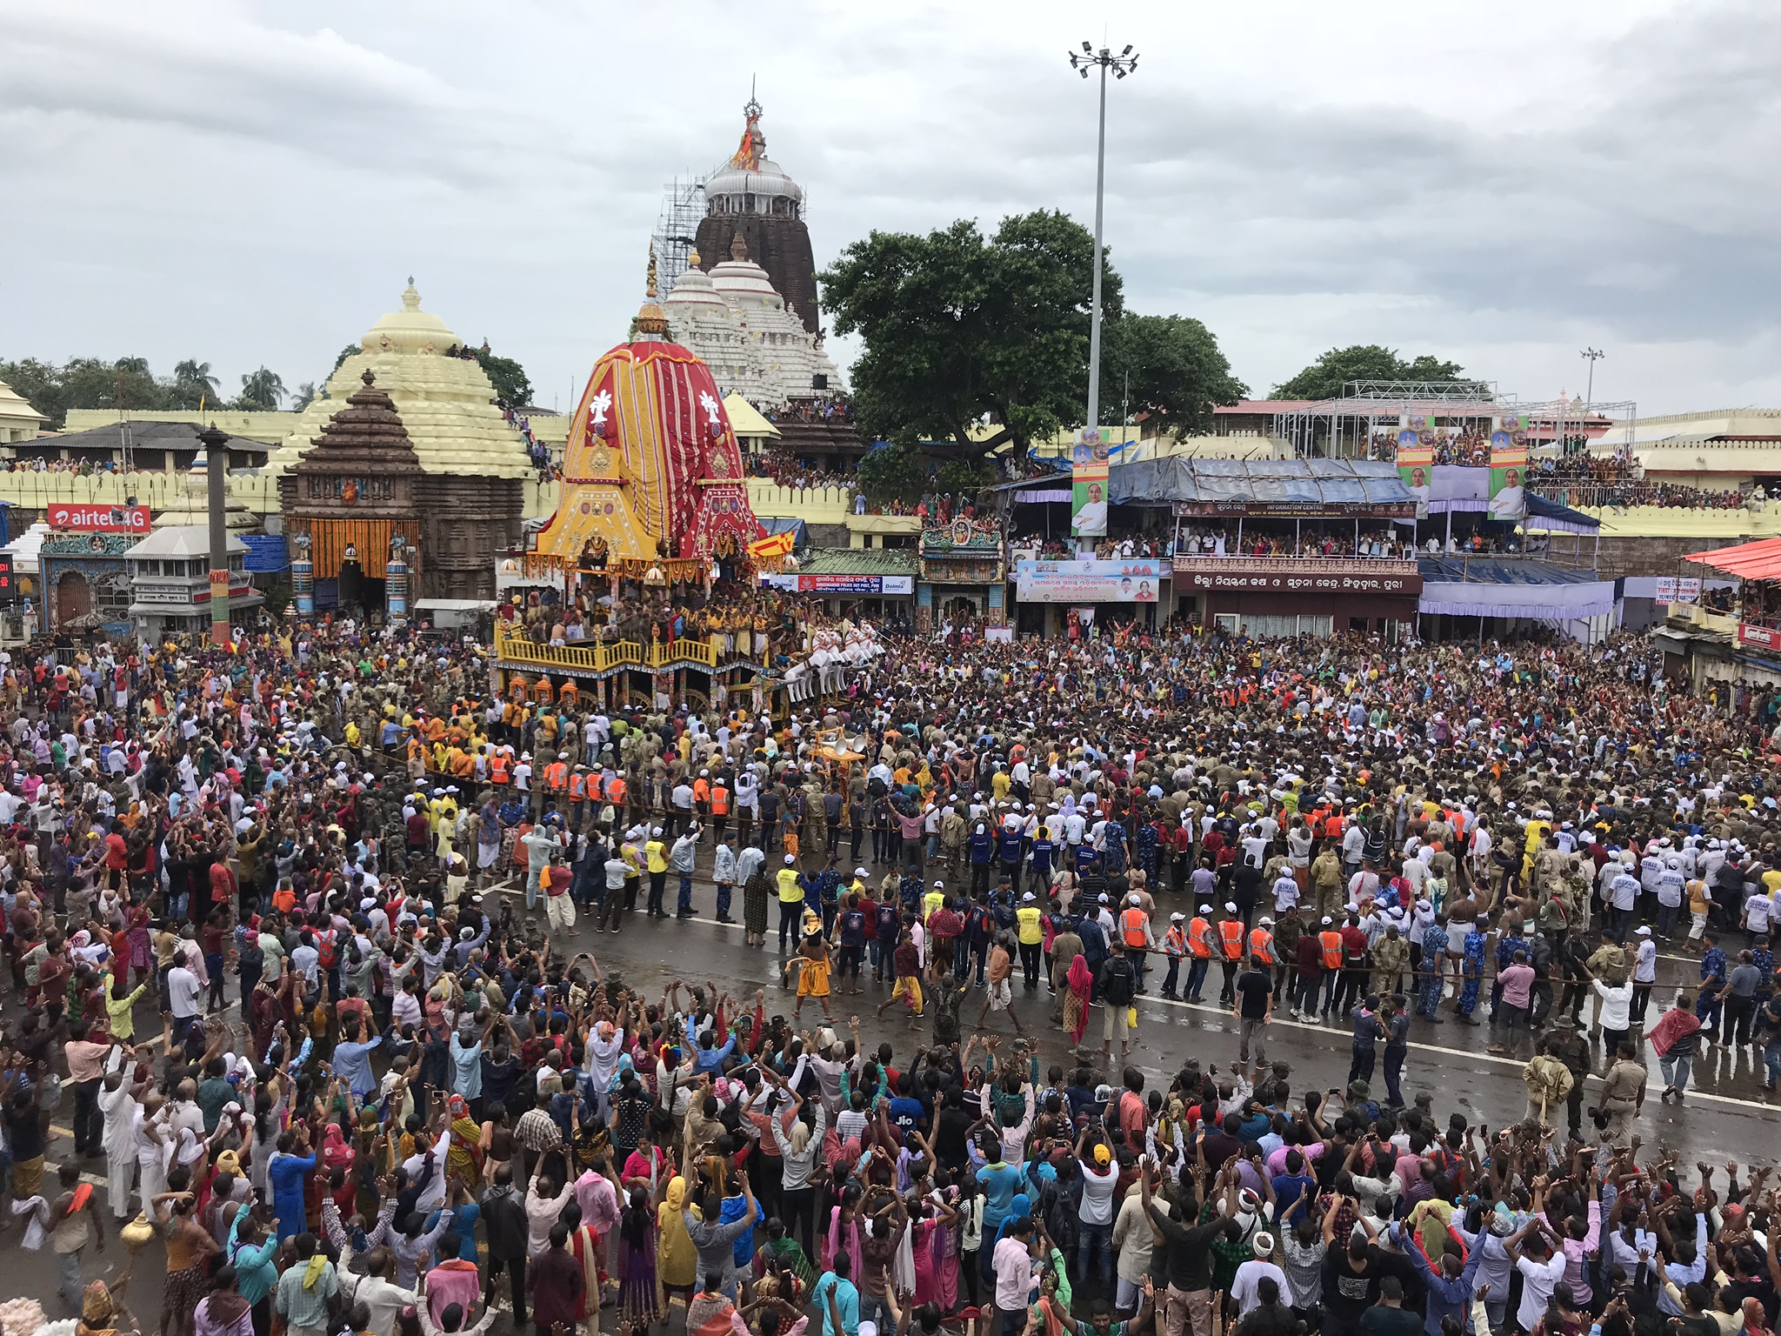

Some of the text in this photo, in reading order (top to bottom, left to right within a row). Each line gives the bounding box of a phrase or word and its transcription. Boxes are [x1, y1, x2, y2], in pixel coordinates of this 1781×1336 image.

[72, 509, 144, 526] airtel 4G
[1272, 578, 1281, 587] ଓ
[1287, 578, 1313, 588] ସୂଚନା
[1384, 579, 1402, 590] ପୁରୀ
[896, 1115, 913, 1126] Jio
